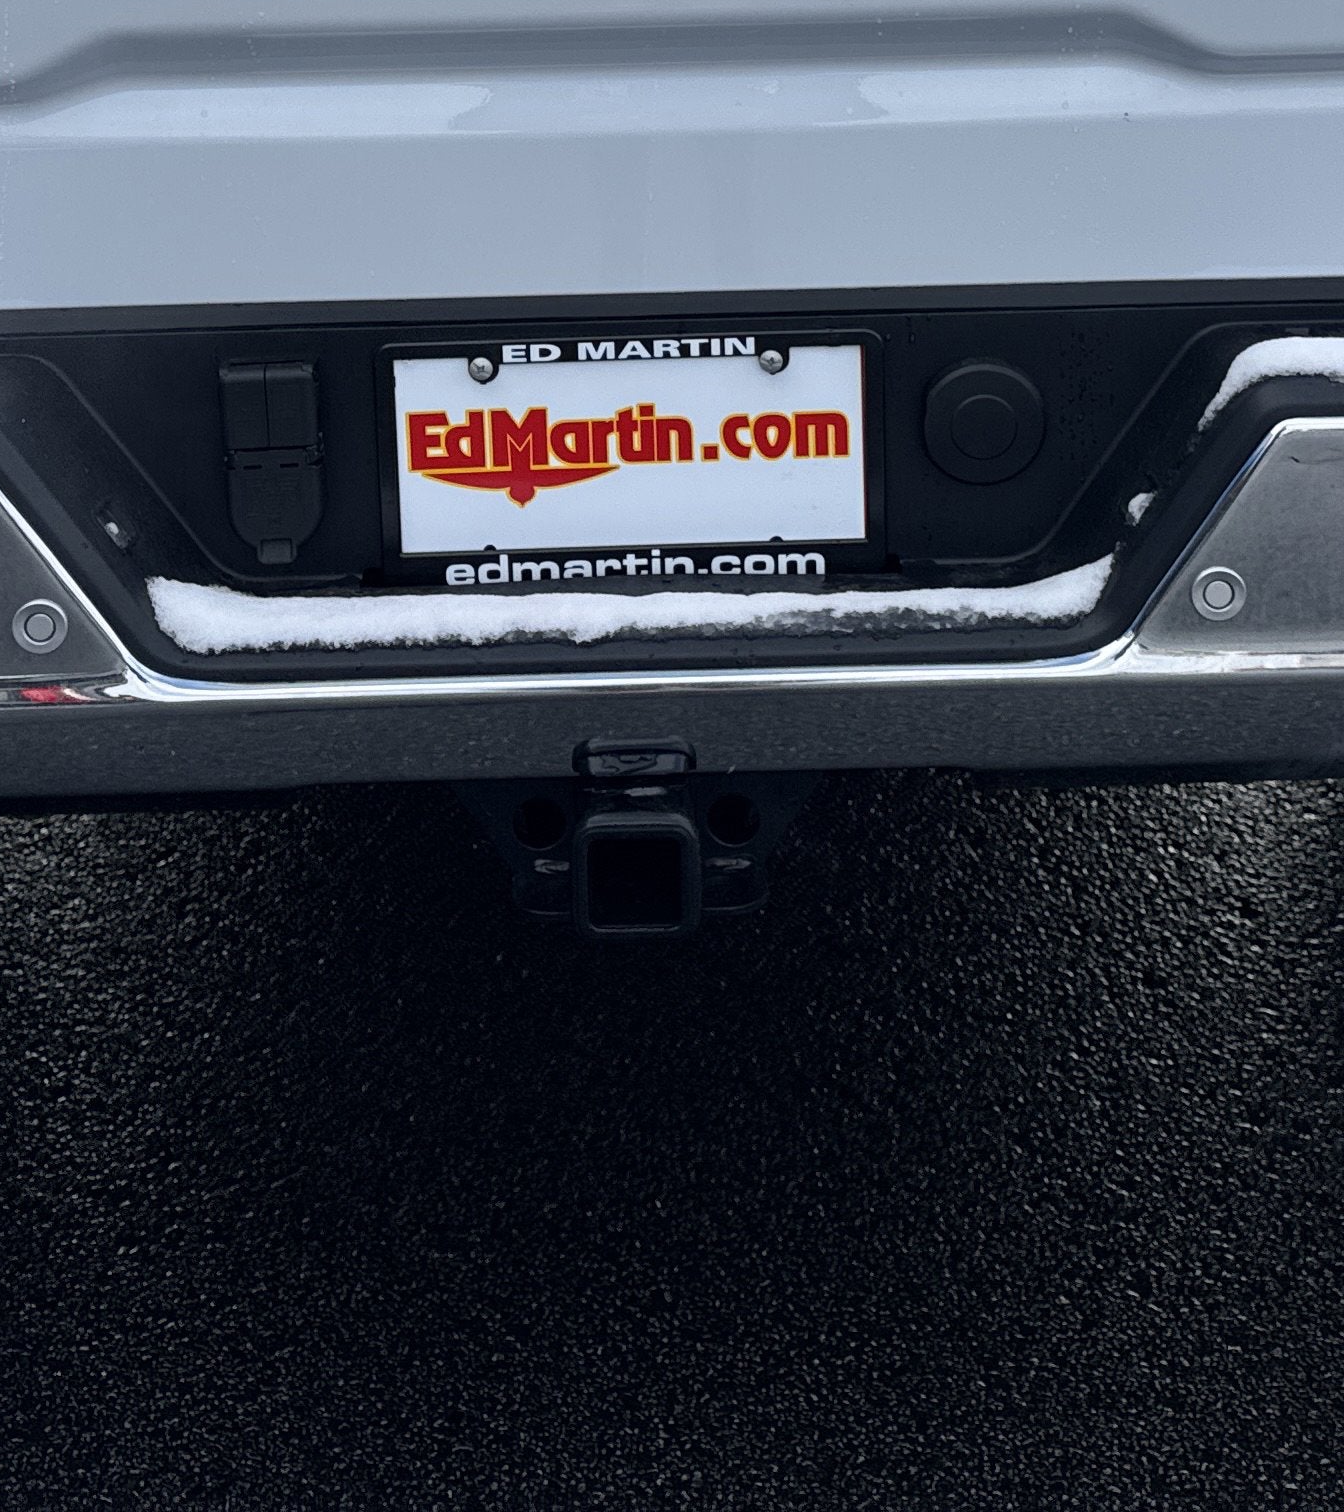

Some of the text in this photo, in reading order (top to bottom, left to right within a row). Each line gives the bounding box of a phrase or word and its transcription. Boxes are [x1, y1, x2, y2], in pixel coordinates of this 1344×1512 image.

[501, 336, 757, 364] ED MARTIN
[445, 549, 826, 586] edmartin.com
